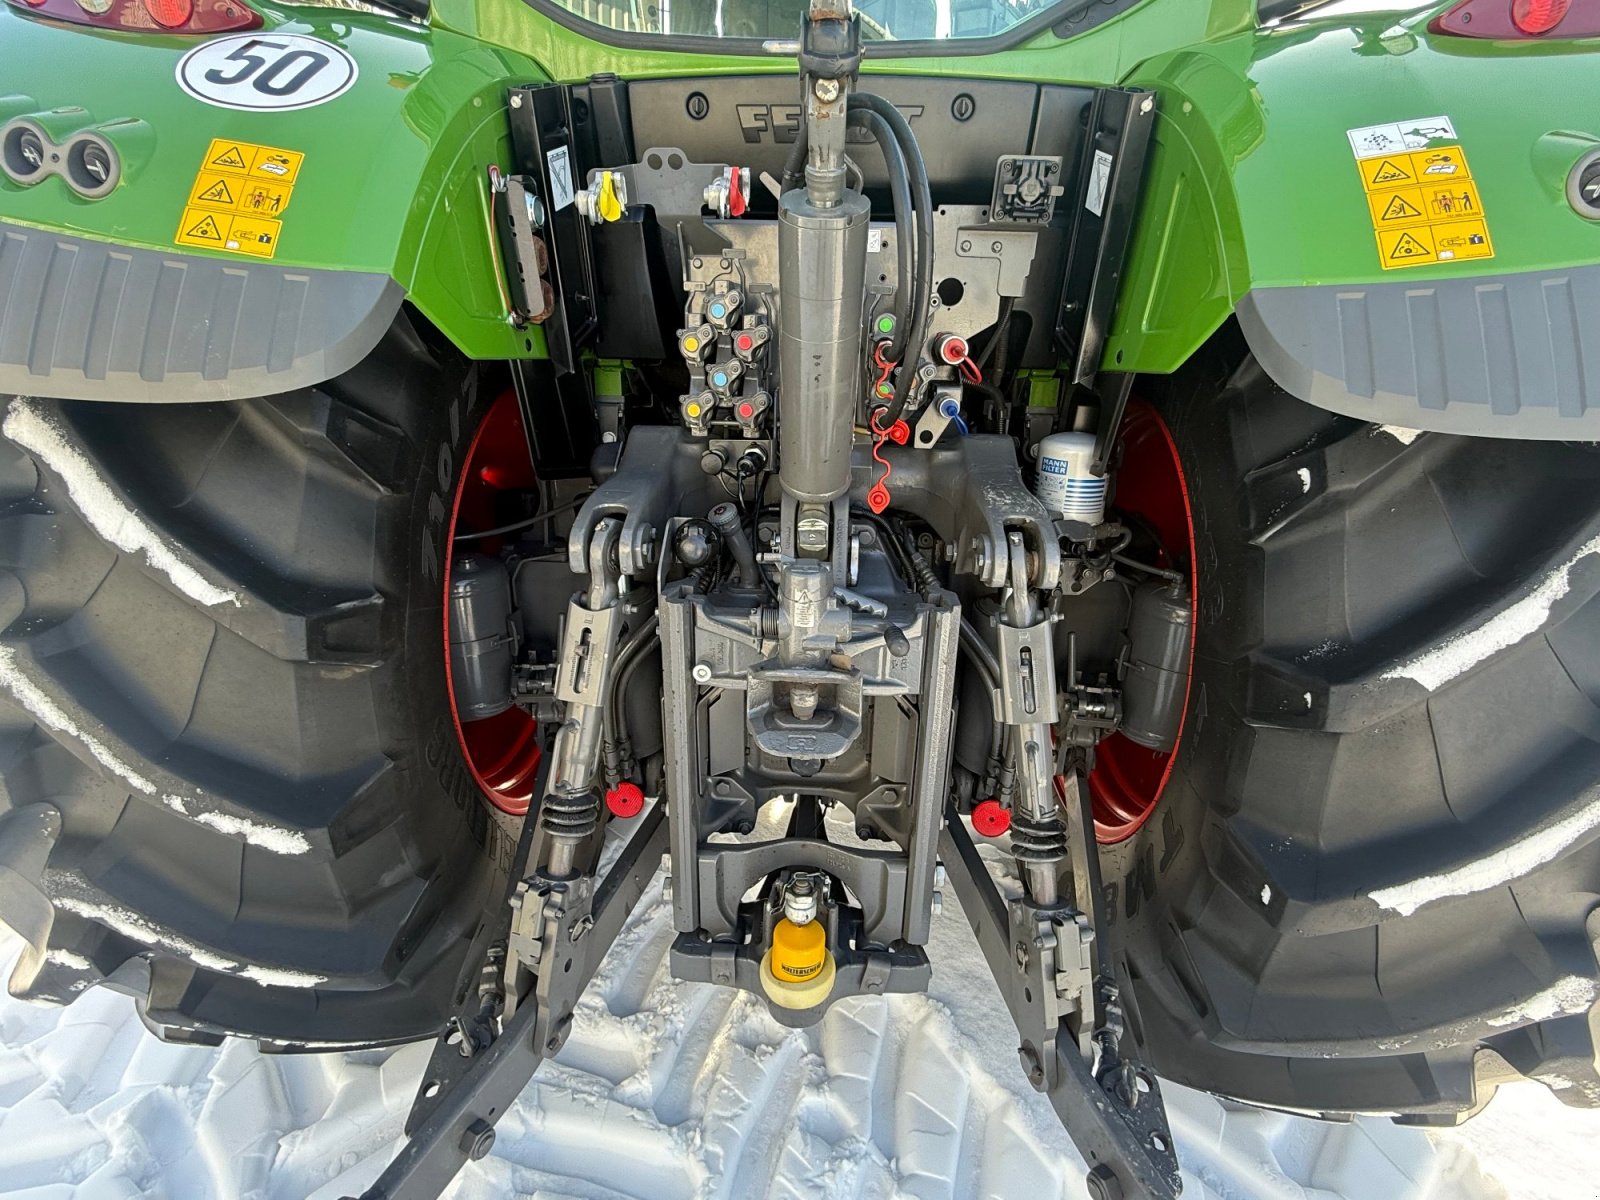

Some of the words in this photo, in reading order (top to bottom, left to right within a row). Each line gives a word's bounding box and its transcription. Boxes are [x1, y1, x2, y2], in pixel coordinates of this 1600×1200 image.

[204, 39, 330, 96] 50
[1043, 458, 1067, 468] MANN
[1042, 464, 1067, 474] FILTER
